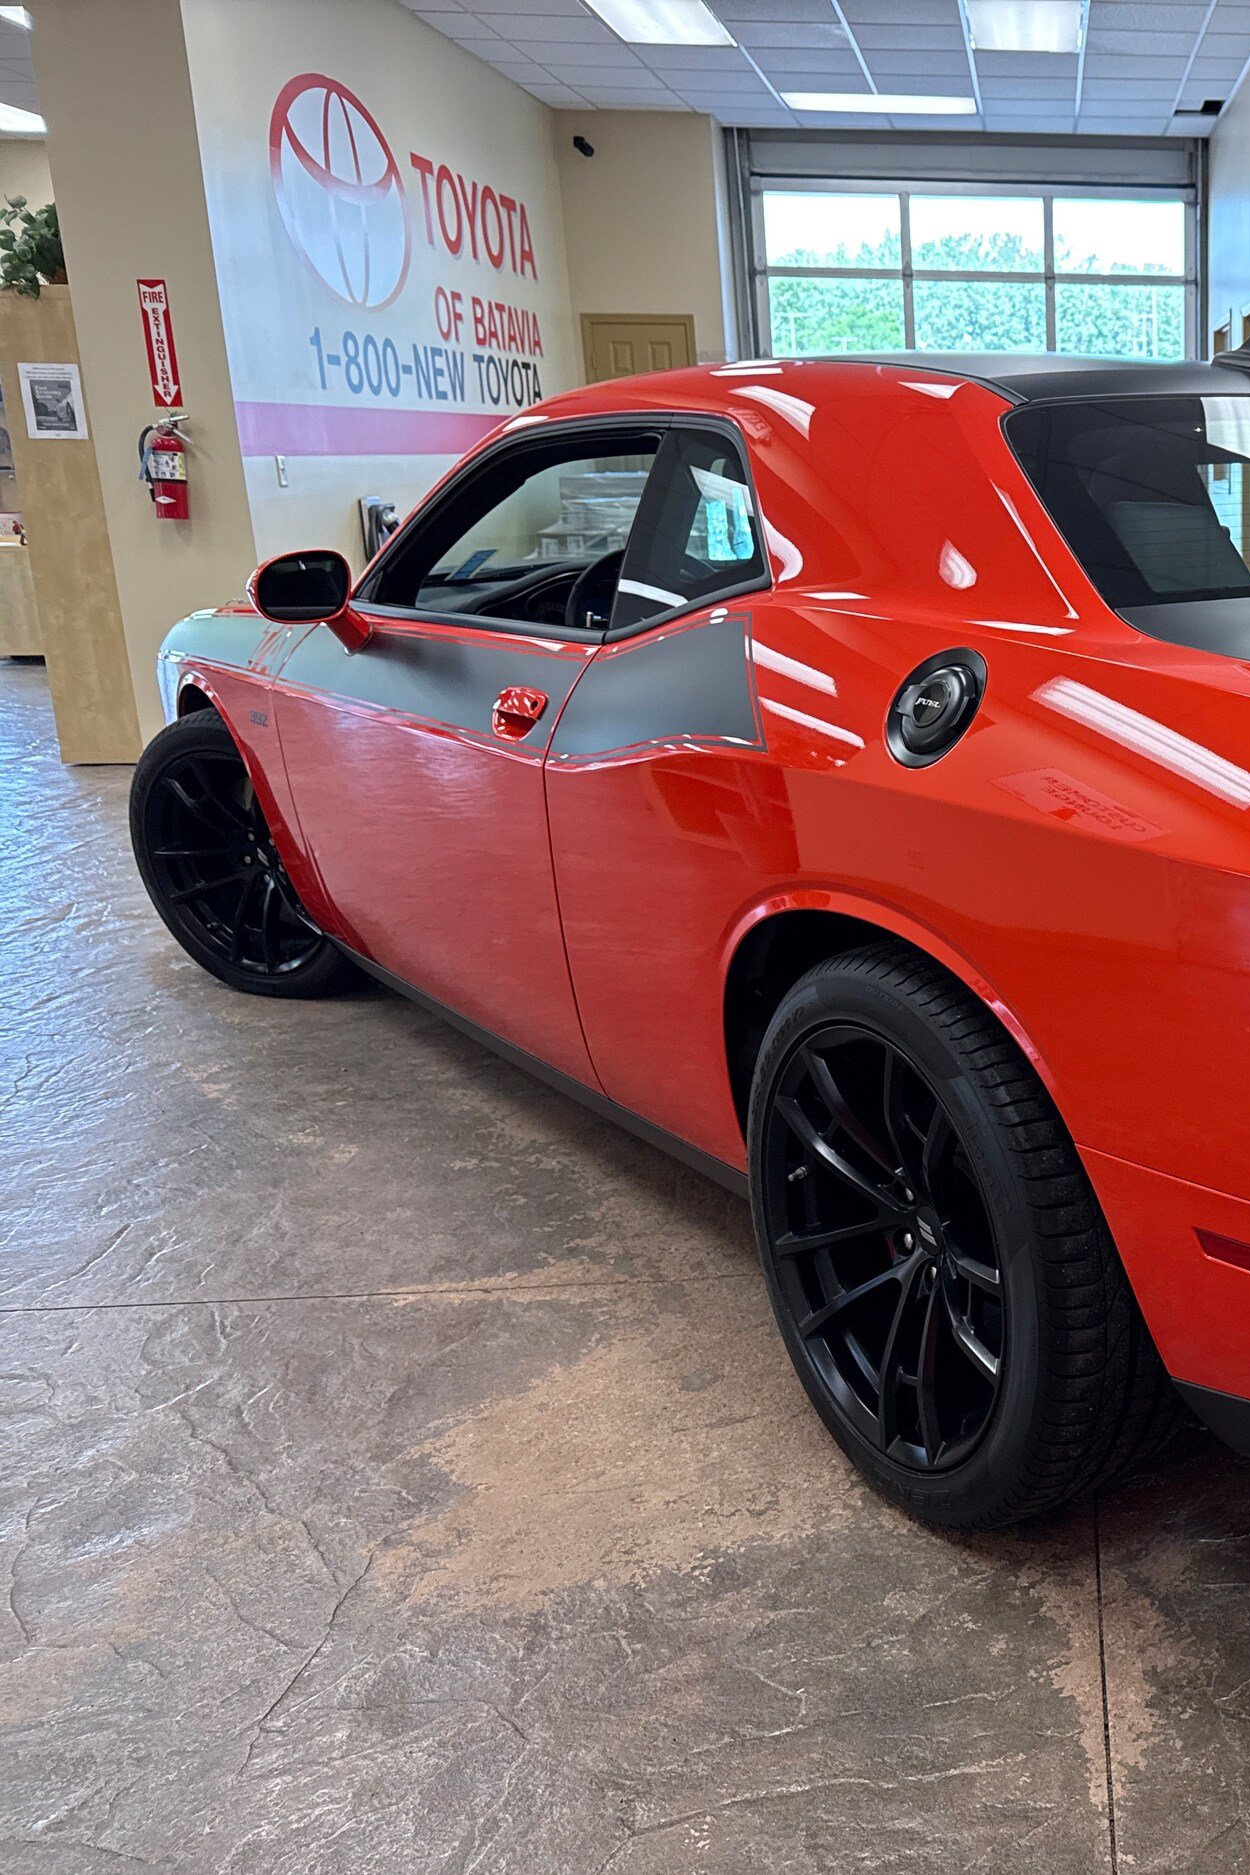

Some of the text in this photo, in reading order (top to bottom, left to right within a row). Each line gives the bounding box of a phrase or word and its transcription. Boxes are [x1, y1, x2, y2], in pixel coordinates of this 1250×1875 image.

[410, 152, 538, 281] TOYOTA
[142, 291, 164, 303] FIRE
[435, 285, 544, 357] OF BATAVIA
[151, 307, 172, 398] EXTINGUISHER
[310, 326, 542, 407] 1-800-NEW TOYOTA
[914, 697, 941, 708] FUEL
